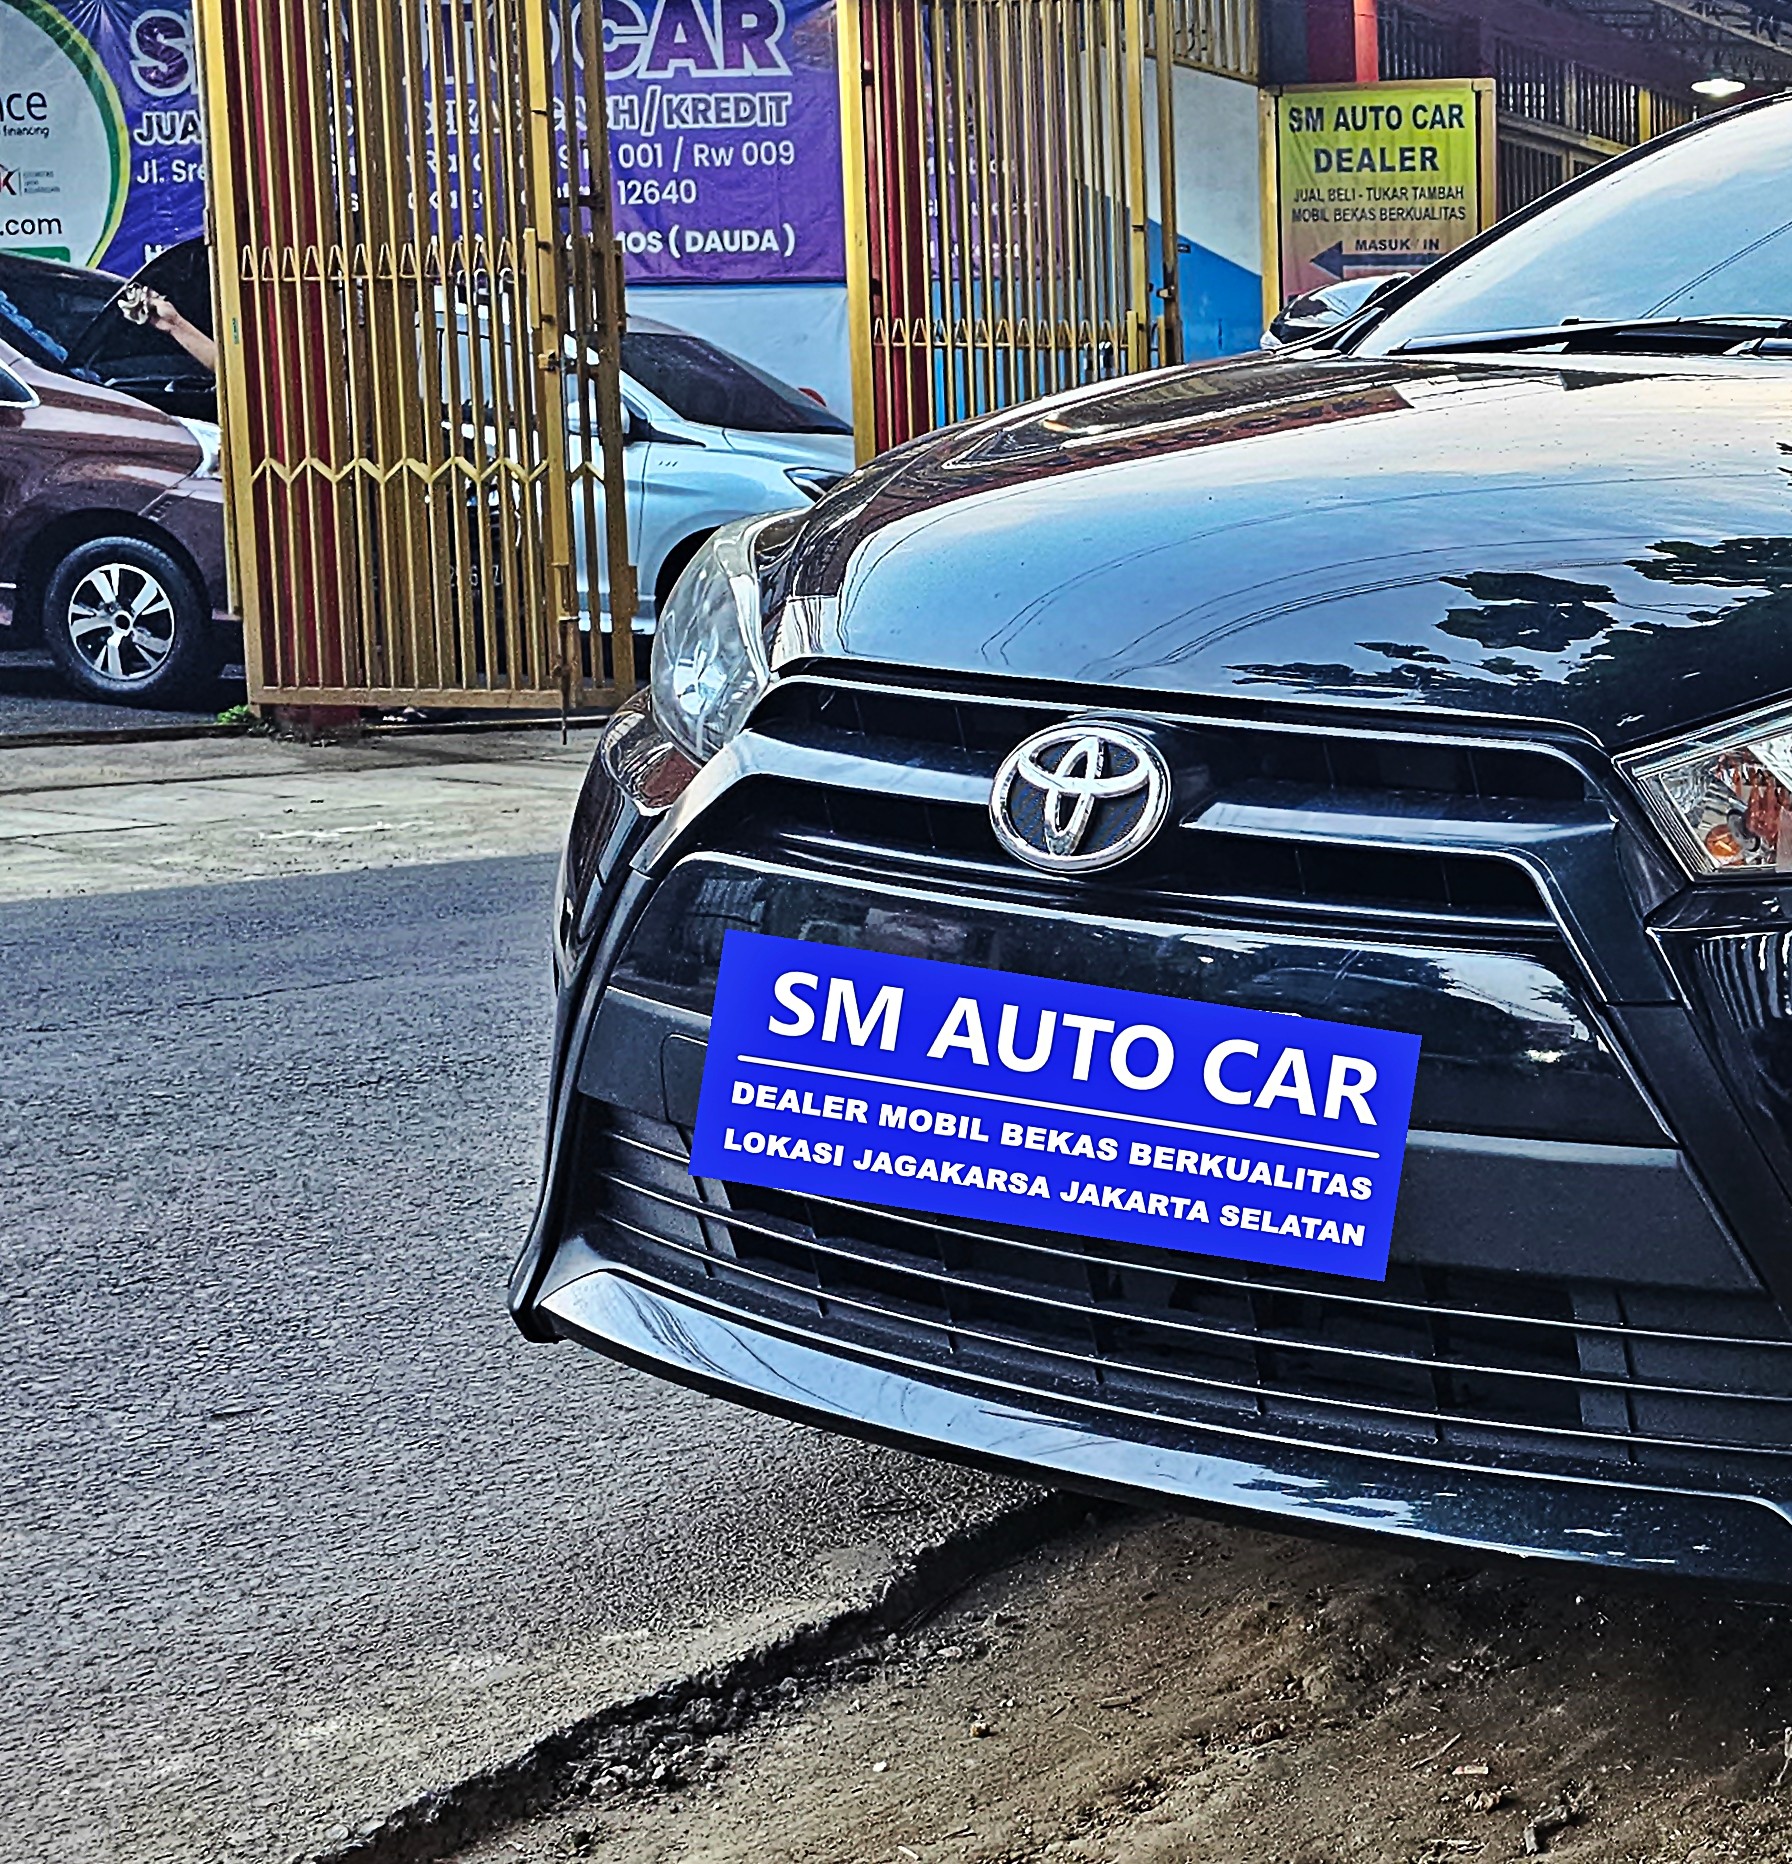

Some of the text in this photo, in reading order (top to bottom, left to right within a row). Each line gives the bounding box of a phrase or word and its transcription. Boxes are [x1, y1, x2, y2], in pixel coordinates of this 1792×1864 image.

[0, 91, 48, 122] ce
[1288, 103, 1466, 133] SM AUTO CAR
[3, 125, 49, 138] financing
[133, 110, 202, 146] JUA
[618, 143, 662, 169] 001
[694, 143, 734, 167] Rw
[742, 141, 795, 165] 009
[1314, 146, 1440, 174] DEALER
[617, 179, 697, 205] 12640
[1294, 187, 1324, 203] JUAL
[1328, 187, 1356, 202] BELI
[1366, 187, 1409, 201] TUKAR
[1411, 185, 1464, 201] TAMBAH
[1292, 206, 1466, 223] MOBIL BEKAS BERKUALITAS
[1355, 238, 1410, 252] MASUK
[1423, 238, 1440, 250] IN
